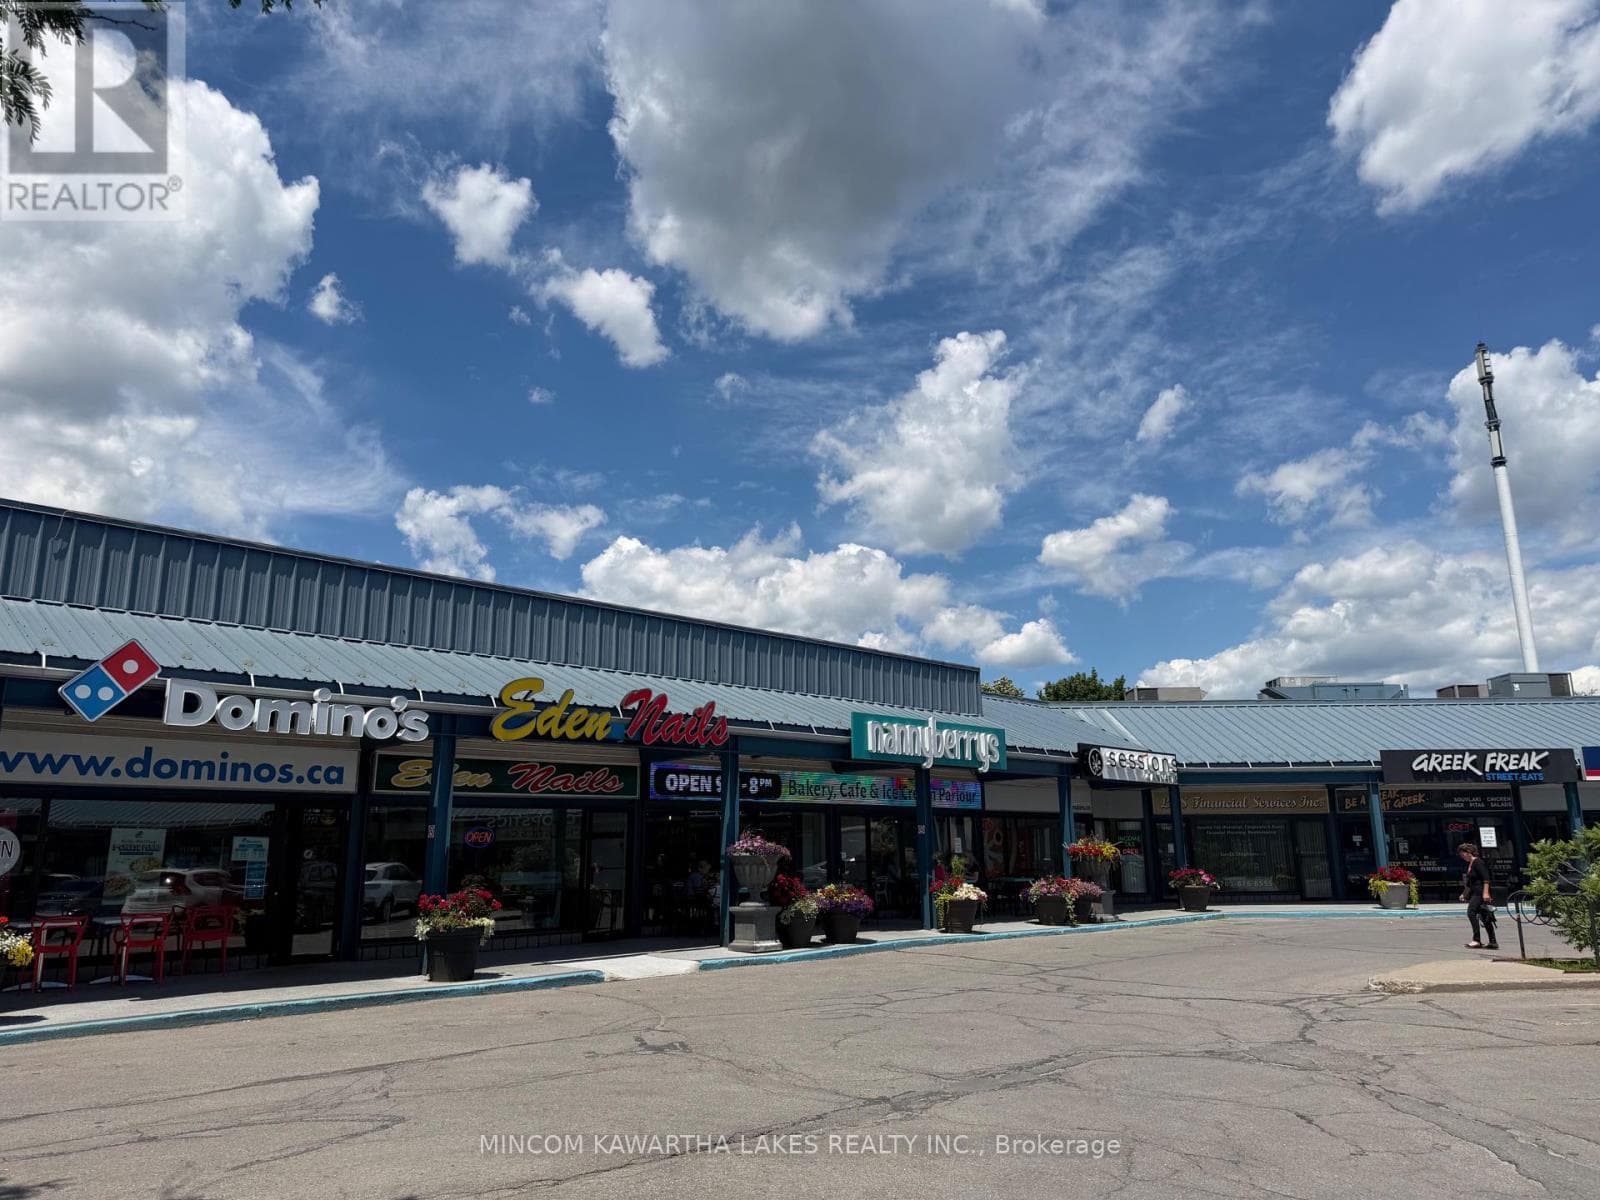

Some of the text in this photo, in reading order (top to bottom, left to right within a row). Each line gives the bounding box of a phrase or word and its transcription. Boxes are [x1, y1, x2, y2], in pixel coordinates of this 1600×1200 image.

[163, 677, 430, 742] Domino's
[490, 677, 731, 746] Eden Nails
[867, 716, 1000, 773] nannyberrys
[1109, 752, 1178, 774] sessions
[1412, 751, 1549, 776] GREEK FREAK
[391, 758, 625, 793] Een Nails
[666, 774, 712, 793] OPEN
[788, 780, 836, 800] Bakery,
[840, 782, 867, 798] Cafe
[870, 783, 879, 798] &
[883, 785, 898, 799] Ice
[1393, 792, 1426, 809] GREEK
[1191, 796, 1247, 809] Financial
[1252, 796, 1297, 809] Services
[1344, 797, 1359, 810] BE
[466, 830, 493, 844] OPEN
